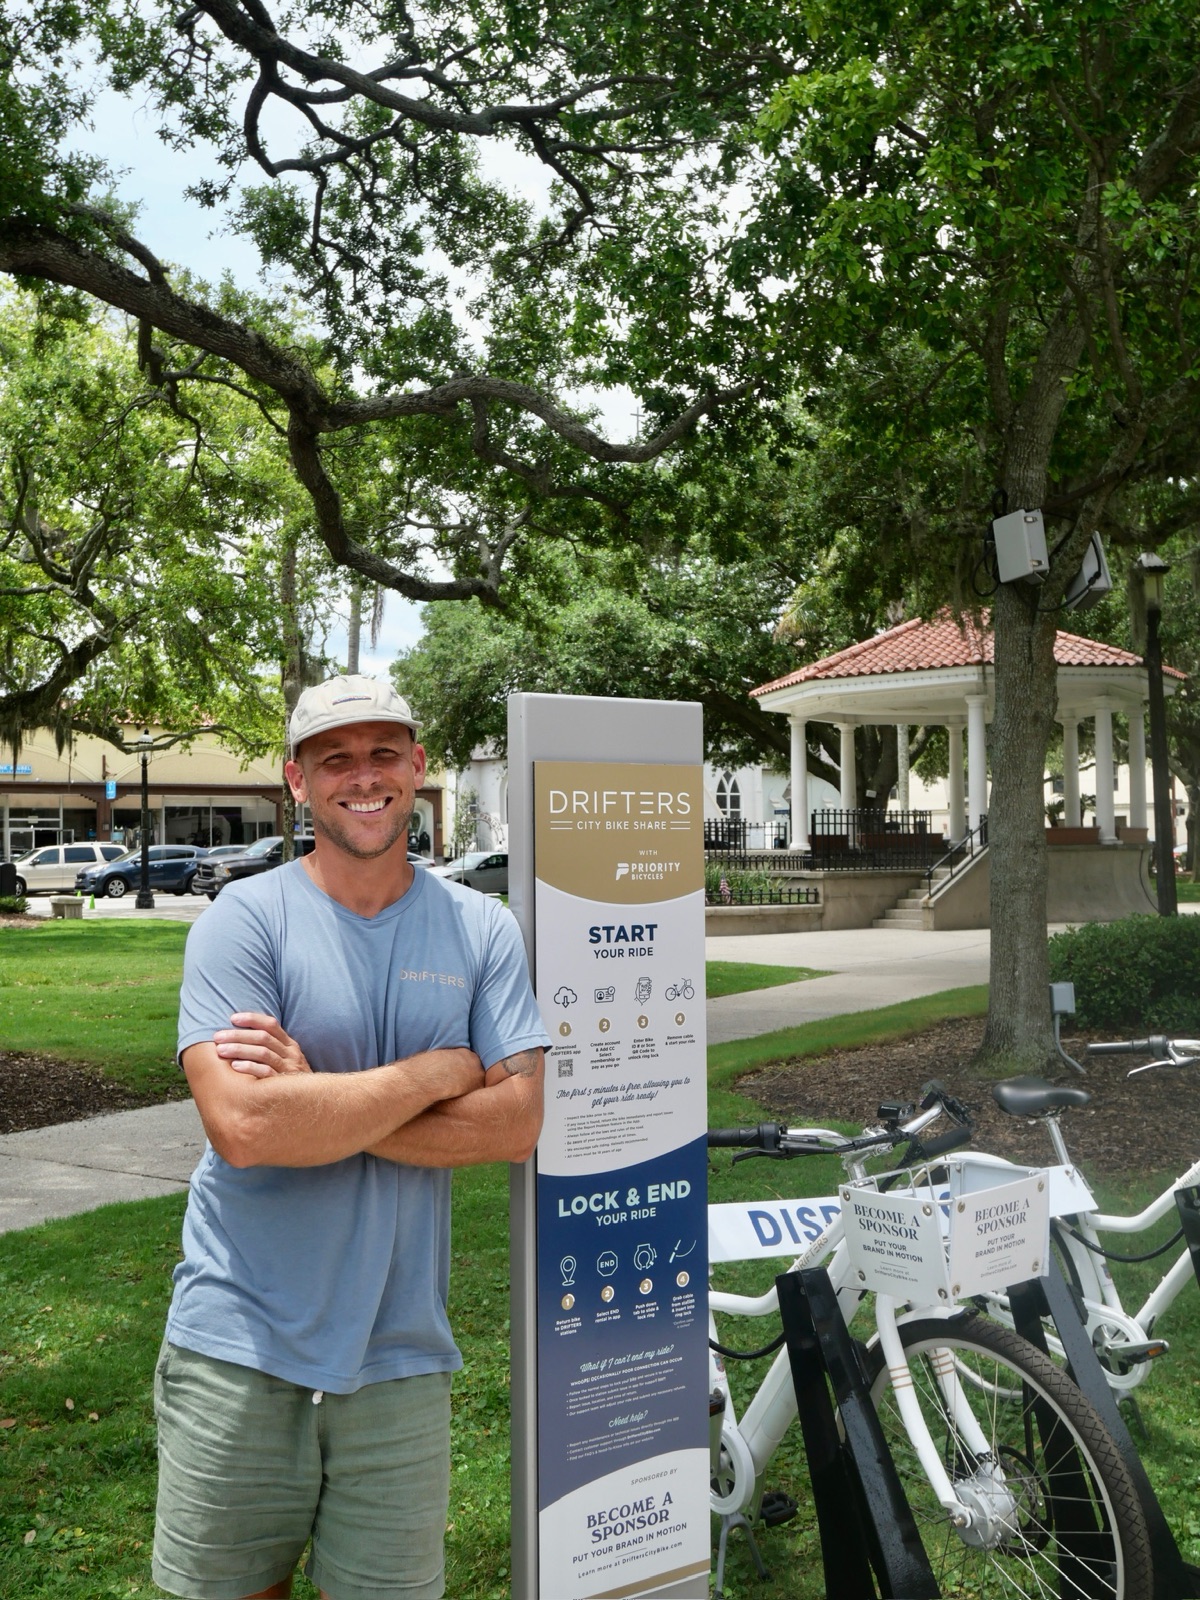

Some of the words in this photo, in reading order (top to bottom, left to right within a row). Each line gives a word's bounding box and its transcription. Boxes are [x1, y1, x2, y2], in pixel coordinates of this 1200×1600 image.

[550, 791, 691, 814] DRIFTERS
[577, 821, 601, 829] CITY
[606, 821, 629, 829] BIKE
[634, 821, 666, 829] SHARE
[632, 863, 680, 872] PRIORITY
[589, 924, 657, 943] START
[594, 949, 624, 959] YOUR
[628, 947, 653, 957] RIDE
[400, 969, 464, 988] DRIFTERS
[590, 1057, 614, 1065] membership
[556, 1090, 569, 1099] The
[570, 1088, 586, 1100] first
[587, 1088, 592, 1096] 5
[593, 1084, 618, 1095] minutes
[620, 1084, 625, 1092] is
[643, 1079, 670, 1089] allowing
[670, 1079, 682, 1088] you
[592, 1097, 602, 1108] get
[603, 1096, 619, 1108] your
[621, 1092, 634, 1101] ride
[636, 1090, 658, 1101] ready!
[558, 1190, 619, 1217] LOCK
[626, 1187, 640, 1206] &
[647, 1180, 691, 1203] END
[596, 1212, 627, 1226] YOUR
[631, 1207, 656, 1220] RIDE
[854, 1204, 906, 1225] BECOME
[911, 1215, 920, 1227] A
[975, 1200, 1019, 1223] BECOME
[1022, 1198, 1030, 1209] A
[859, 1218, 919, 1240] SPONSOR
[977, 1212, 1026, 1236] SPONSOR
[874, 1239, 886, 1247] PUT
[888, 1242, 907, 1251] YOUR
[975, 1248, 995, 1258] BRAND
[1004, 1238, 1025, 1249] MOTION
[987, 1237, 998, 1246] PUT
[1000, 1234, 1015, 1243] YOUR
[863, 1244, 885, 1255] BRAND
[895, 1252, 923, 1263] MOTION
[600, 1260, 614, 1268] END
[560, 1322, 582, 1330] DRIFTERS
[580, 1361, 600, 1372] What
[600, 1360, 607, 1371] if
[608, 1358, 614, 1368] I
[614, 1354, 630, 1366] can't
[631, 1352, 643, 1361] end
[644, 1350, 655, 1360] my
[656, 1344, 674, 1356] ride?
[590, 1371, 621, 1382] OCCASIONALLY
[634, 1362, 659, 1372] CONNECTION
[608, 1416, 630, 1428] Need
[630, 1410, 648, 1423] help?
[631, 1470, 668, 1485] SPONSORED
[587, 1496, 655, 1528] BECOME
[662, 1491, 674, 1506] A
[591, 1508, 670, 1544] SPONSOR
[572, 1552, 588, 1564] PUT
[591, 1545, 613, 1558] YOUR
[616, 1536, 644, 1551] BRAND
[646, 1532, 654, 1541] IN
[656, 1522, 687, 1538] MOTION
[578, 1568, 595, 1579] Learn
[597, 1564, 612, 1572] more
[622, 1542, 682, 1564] DriftersCityBike.com
